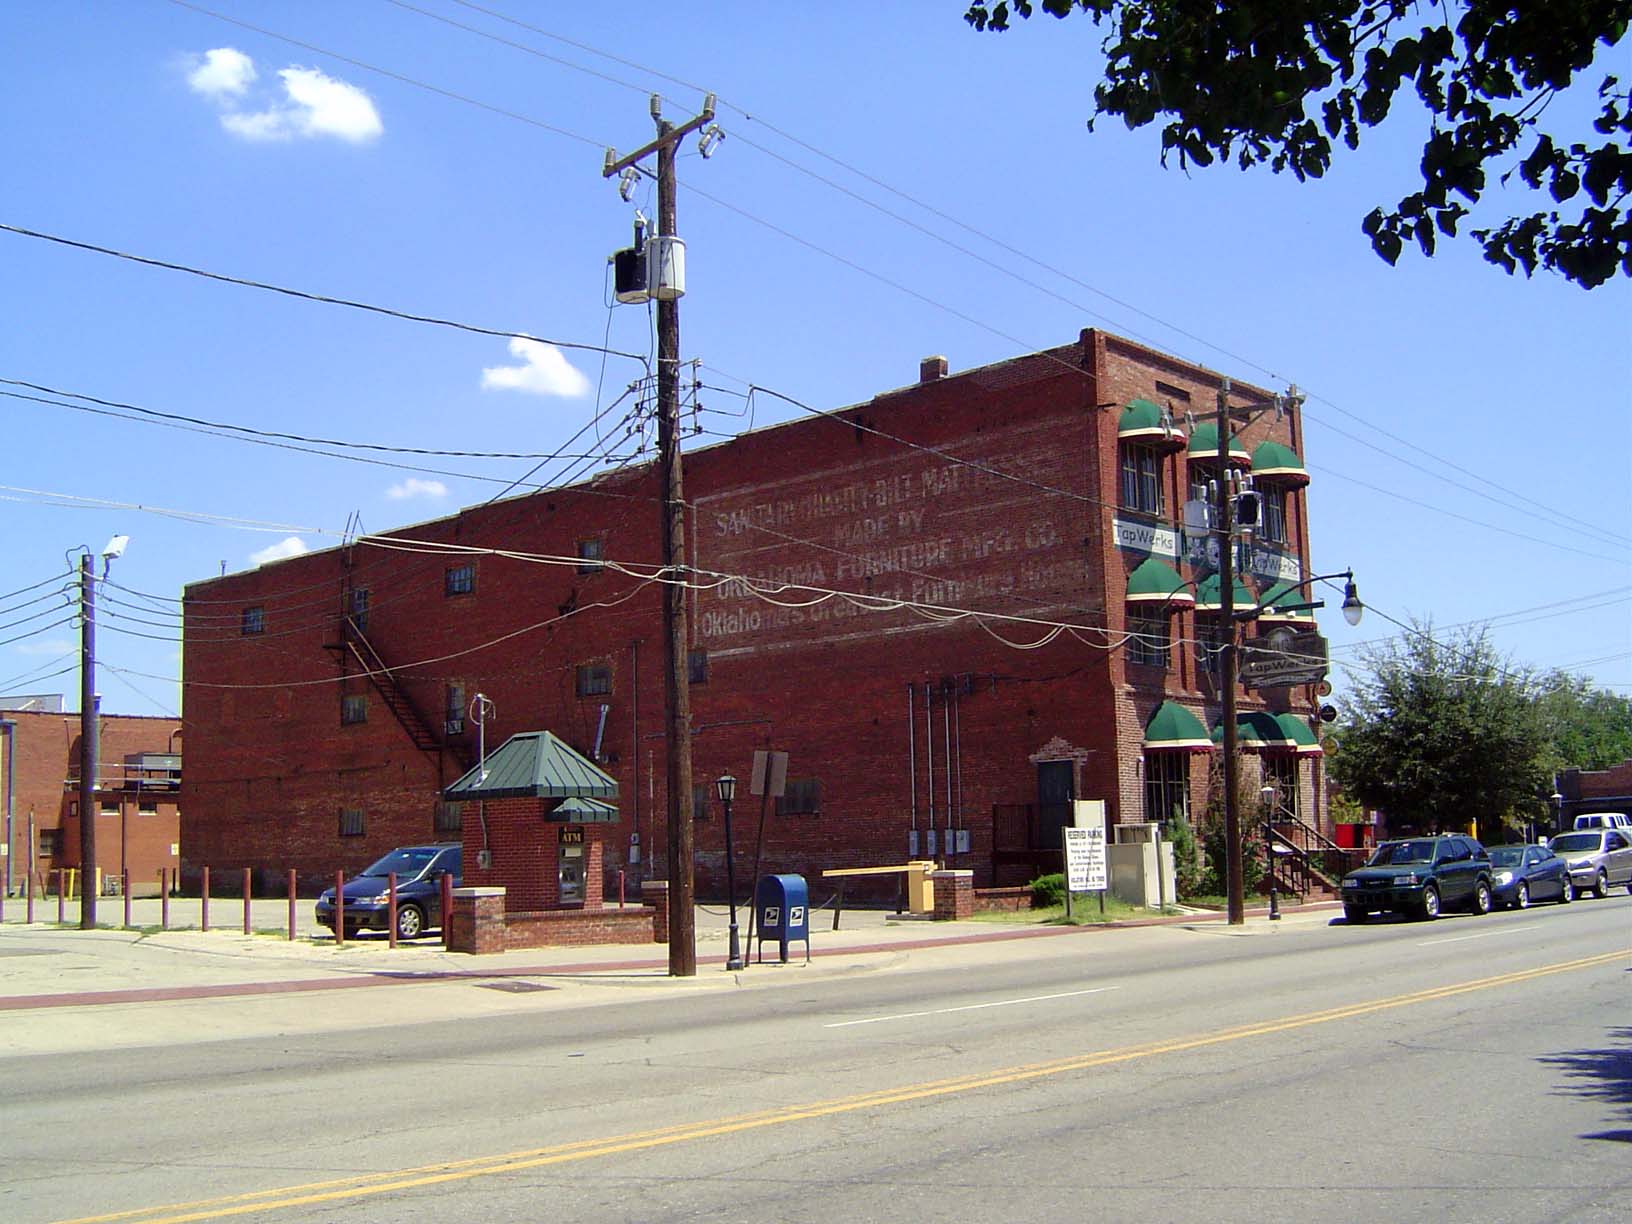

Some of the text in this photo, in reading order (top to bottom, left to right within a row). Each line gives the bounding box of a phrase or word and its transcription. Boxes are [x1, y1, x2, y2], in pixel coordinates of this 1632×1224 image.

[1118, 525, 1174, 549] TapWerks
[837, 538, 951, 580] FURNITURE
[563, 833, 581, 842] ATM
